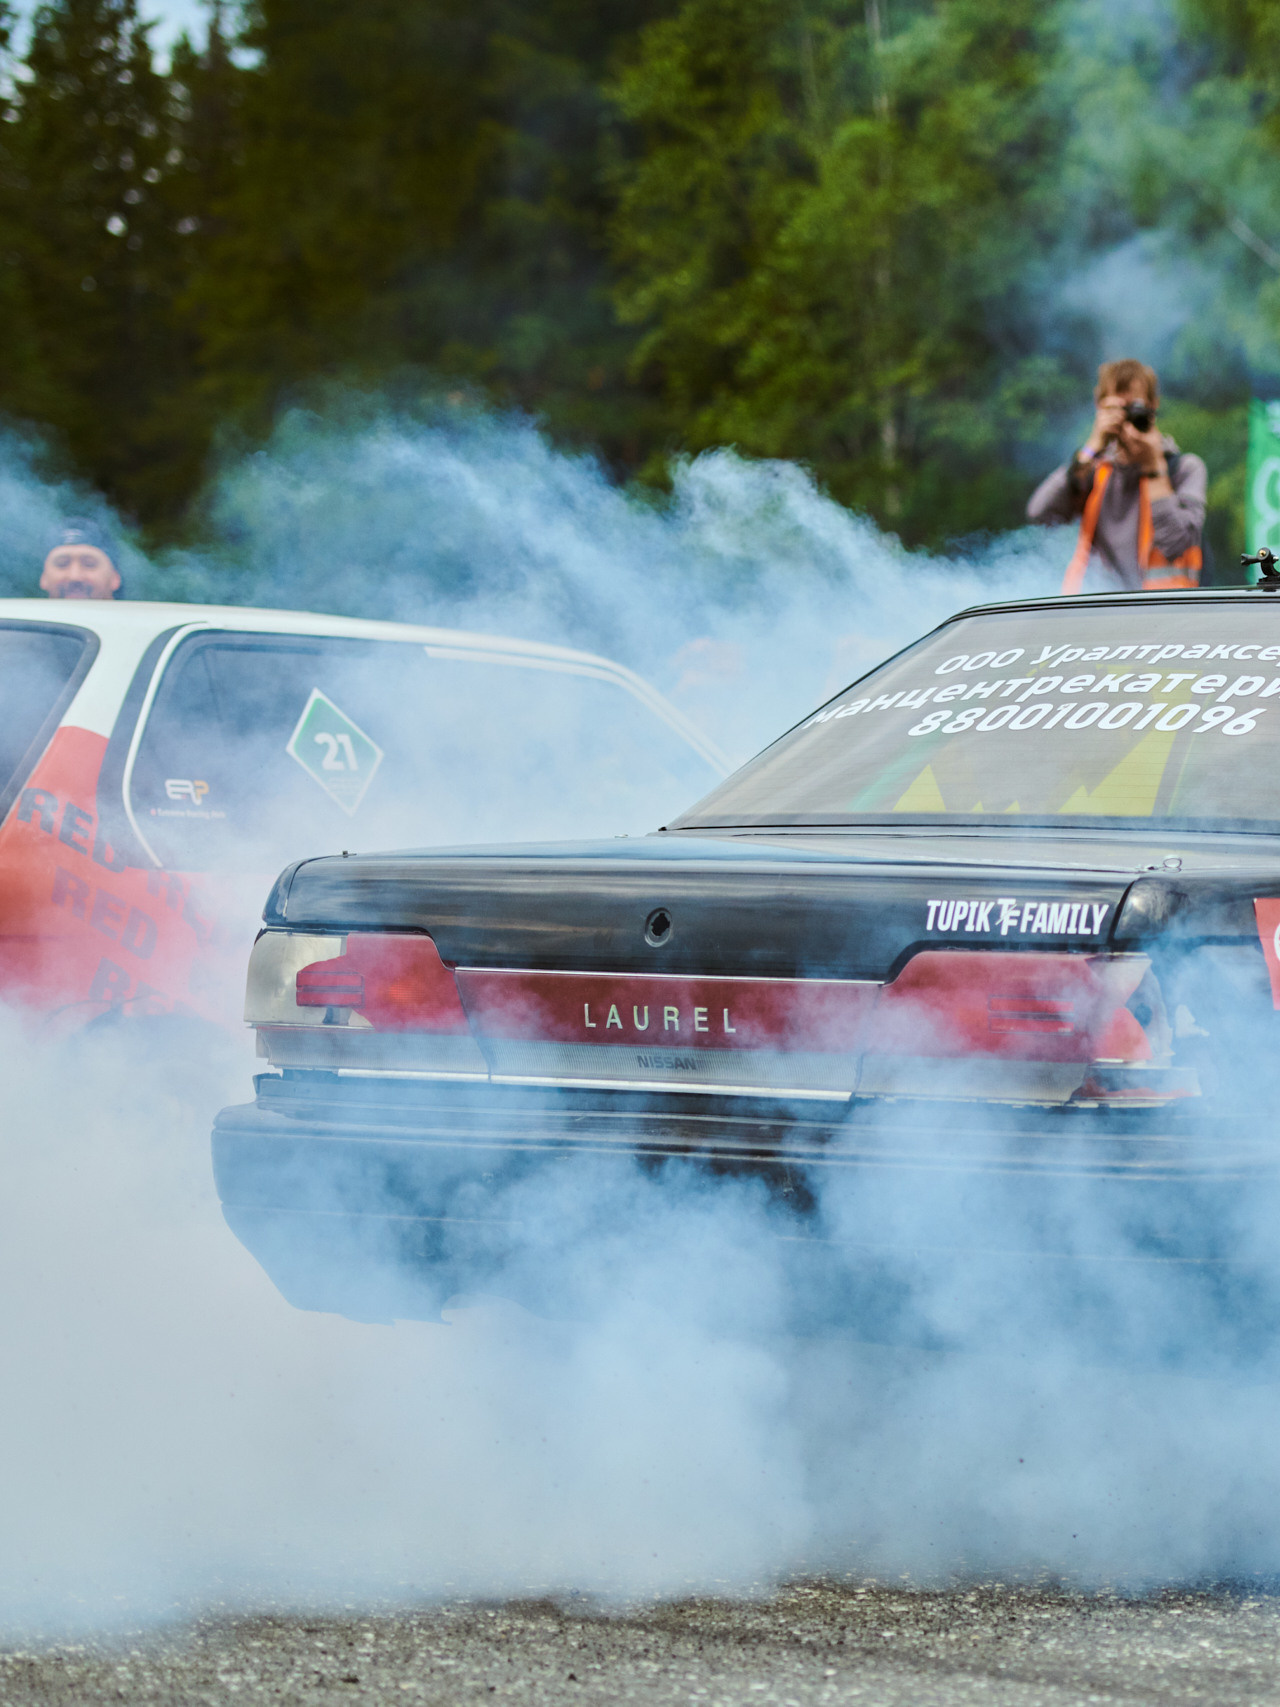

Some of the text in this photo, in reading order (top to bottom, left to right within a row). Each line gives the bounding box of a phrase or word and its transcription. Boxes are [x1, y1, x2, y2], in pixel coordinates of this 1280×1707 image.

[935, 648, 1026, 675] ООО
[907, 701, 1267, 737] 88001001096
[313, 731, 359, 772] 21
[51, 865, 159, 960] RED
[926, 900, 995, 933] TUPIK
[1019, 902, 1110, 935] FAMILY
[583, 1003, 737, 1033] LAUREL
[637, 1055, 697, 1070] NISSAN
